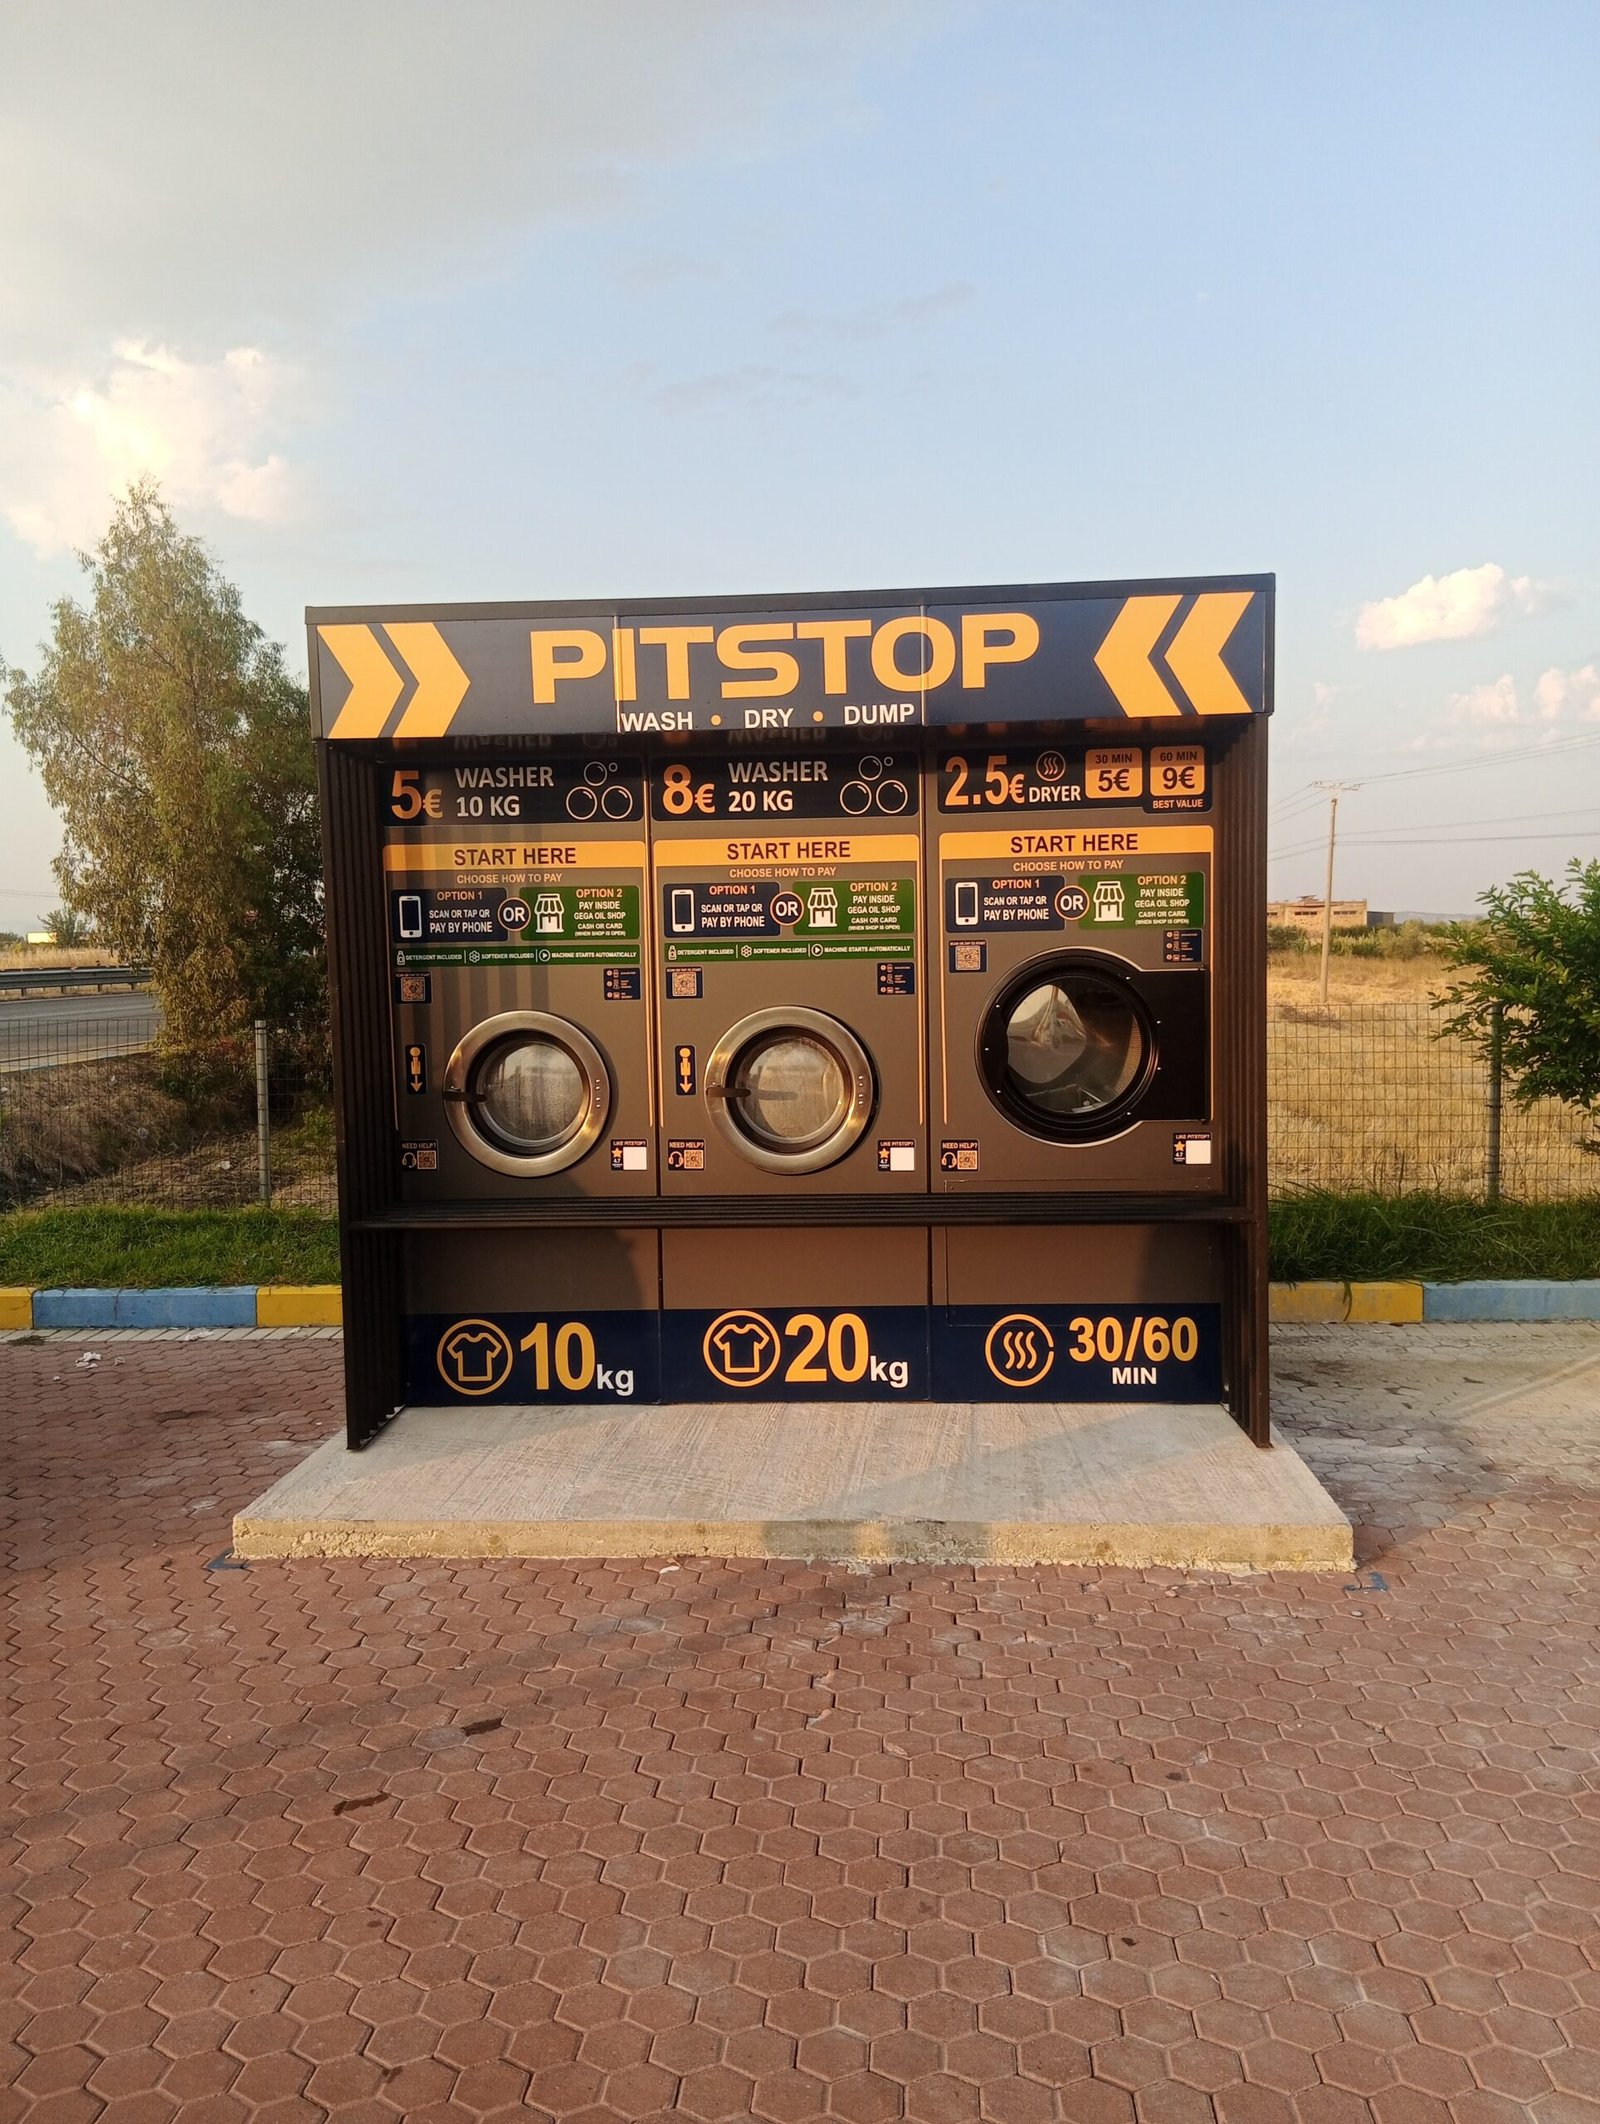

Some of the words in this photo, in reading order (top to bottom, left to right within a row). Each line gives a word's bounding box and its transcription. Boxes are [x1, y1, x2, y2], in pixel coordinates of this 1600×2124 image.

[530, 612, 1040, 704] PITSTOP
[621, 712, 692, 732] WASH
[744, 708, 793, 729] DRY
[844, 704, 915, 725] DUMP
[1095, 754, 1108, 764] 30
[1111, 754, 1132, 763] MIN
[1160, 752, 1173, 762] 60
[1176, 752, 1198, 761] MIN
[455, 766, 554, 789] WASHER
[728, 761, 829, 783] WASHER
[1162, 766, 1195, 790] 9€
[945, 755, 1024, 806] 2.5€
[1098, 769, 1130, 792] 5€
[391, 770, 443, 820] 5€
[662, 764, 715, 814] 8€
[1029, 786, 1081, 803] DRYER
[456, 796, 483, 817] 10
[491, 795, 520, 816] KG
[728, 791, 756, 812] 20
[763, 790, 793, 811] KG
[1153, 800, 1174, 809] BEST
[1176, 799, 1203, 808] VALUE
[1011, 836, 1075, 854] START
[1083, 834, 1138, 852] HERE
[727, 843, 790, 860] START
[797, 841, 850, 858] HERE
[454, 849, 516, 866] START
[524, 848, 576, 864] HERE
[1013, 862, 1057, 872] CHOOSE
[1059, 861, 1085, 871] HOW
[1087, 860, 1101, 870] TO
[1104, 860, 1123, 869] PAY
[457, 874, 499, 884] CHOOSE
[502, 874, 526, 884] HOW
[528, 874, 542, 883] TO
[544, 873, 562, 882] PAY
[730, 869, 772, 878] CHOOSE
[775, 868, 799, 877] HOW
[801, 867, 815, 877] TO
[817, 867, 836, 876] PAY
[992, 879, 1033, 889] OPTION
[1035, 879, 1040, 888] 1
[1138, 875, 1178, 885] OPTION
[1180, 875, 1186, 884] 2
[709, 886, 748, 895] OPTION
[750, 886, 755, 894] 1
[850, 883, 889, 892] OPTION
[891, 882, 897, 892] 2
[1140, 889, 1155, 897] PAY
[1157, 888, 1183, 897] INSIDE
[437, 891, 476, 901] OPTION
[478, 891, 482, 900] 1
[576, 889, 614, 898] OPTION
[616, 889, 622, 898] 2
[853, 895, 867, 904] PAY
[869, 895, 894, 903] INSIDE
[579, 901, 593, 910] PAY
[595, 901, 620, 910] INSIDE
[983, 896, 1005, 906] SCAN
[1006, 896, 1018, 905] OR
[1020, 896, 1034, 905] TAP
[1035, 896, 1047, 905] QR
[1060, 895, 1084, 911] OR
[1135, 899, 1155, 908] GEGA
[1157, 899, 1168, 908] OIL
[1170, 899, 1189, 907] SHOP
[429, 910, 449, 919] SCAN
[451, 910, 462, 918] OR
[464, 910, 477, 918] TAP
[479, 909, 490, 918] QR
[701, 904, 722, 913] SCAN
[723, 904, 735, 912] OR
[736, 904, 750, 912] TAP
[751, 903, 762, 912] QR
[776, 901, 798, 916] OR
[848, 906, 867, 914] GEGA
[869, 905, 880, 913] OIL
[881, 905, 900, 913] SHOP
[503, 907, 526, 922] OR
[574, 912, 593, 920] GEGA
[595, 912, 605, 920] OIL
[607, 911, 626, 920] SHOP
[984, 909, 1002, 921] PAY
[1003, 909, 1016, 920] BY
[1017, 908, 1049, 920] PHONE
[429, 923, 447, 934] PAY
[449, 923, 460, 933] BY
[462, 922, 492, 933] PHONE
[702, 917, 719, 928] PAY
[721, 917, 733, 927] BY
[734, 916, 765, 927] PHONE
[1069, 1317, 1198, 1362] 30/60
[1112, 1367, 1157, 1385] MIN
